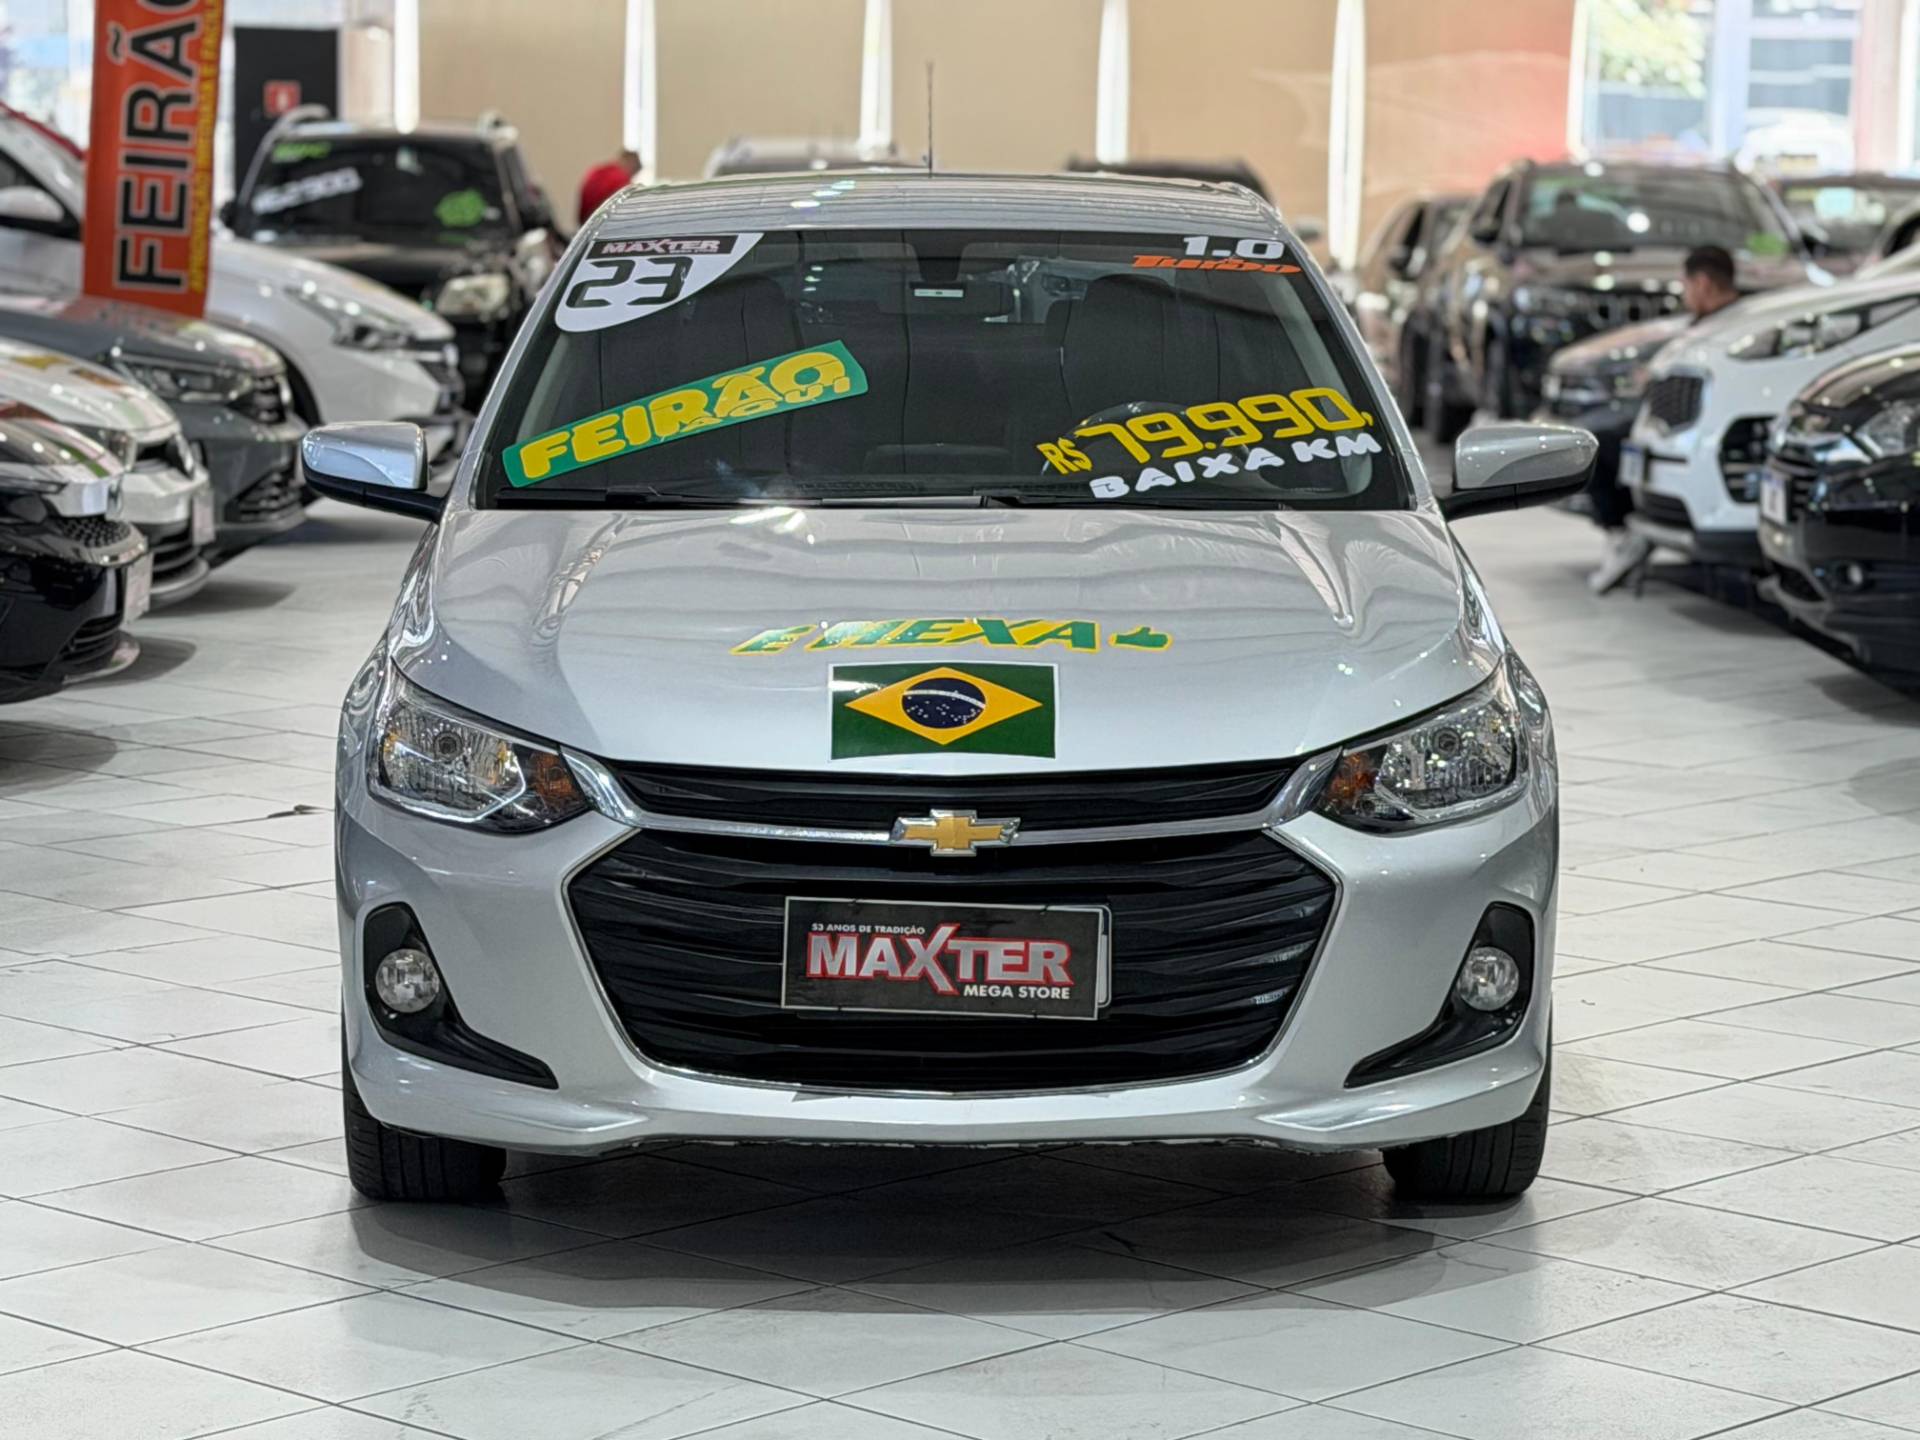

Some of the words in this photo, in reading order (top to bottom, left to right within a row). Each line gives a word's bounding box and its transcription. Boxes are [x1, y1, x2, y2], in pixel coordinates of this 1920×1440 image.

[111, 0, 203, 288] FEIRÃ
[601, 238, 721, 254] MAXTER
[1183, 236, 1285, 260] 1.0
[565, 256, 693, 308] 23
[519, 351, 847, 479] FEIRÃO
[1089, 447, 1285, 499] BAIXA
[1291, 432, 1382, 463] KM
[826, 923, 856, 933] ANOS
[859, 924, 872, 933] DE
[806, 923, 1074, 996] MAXTER
[963, 984, 1013, 998] MEGA
[1018, 985, 1070, 1000] STORE
